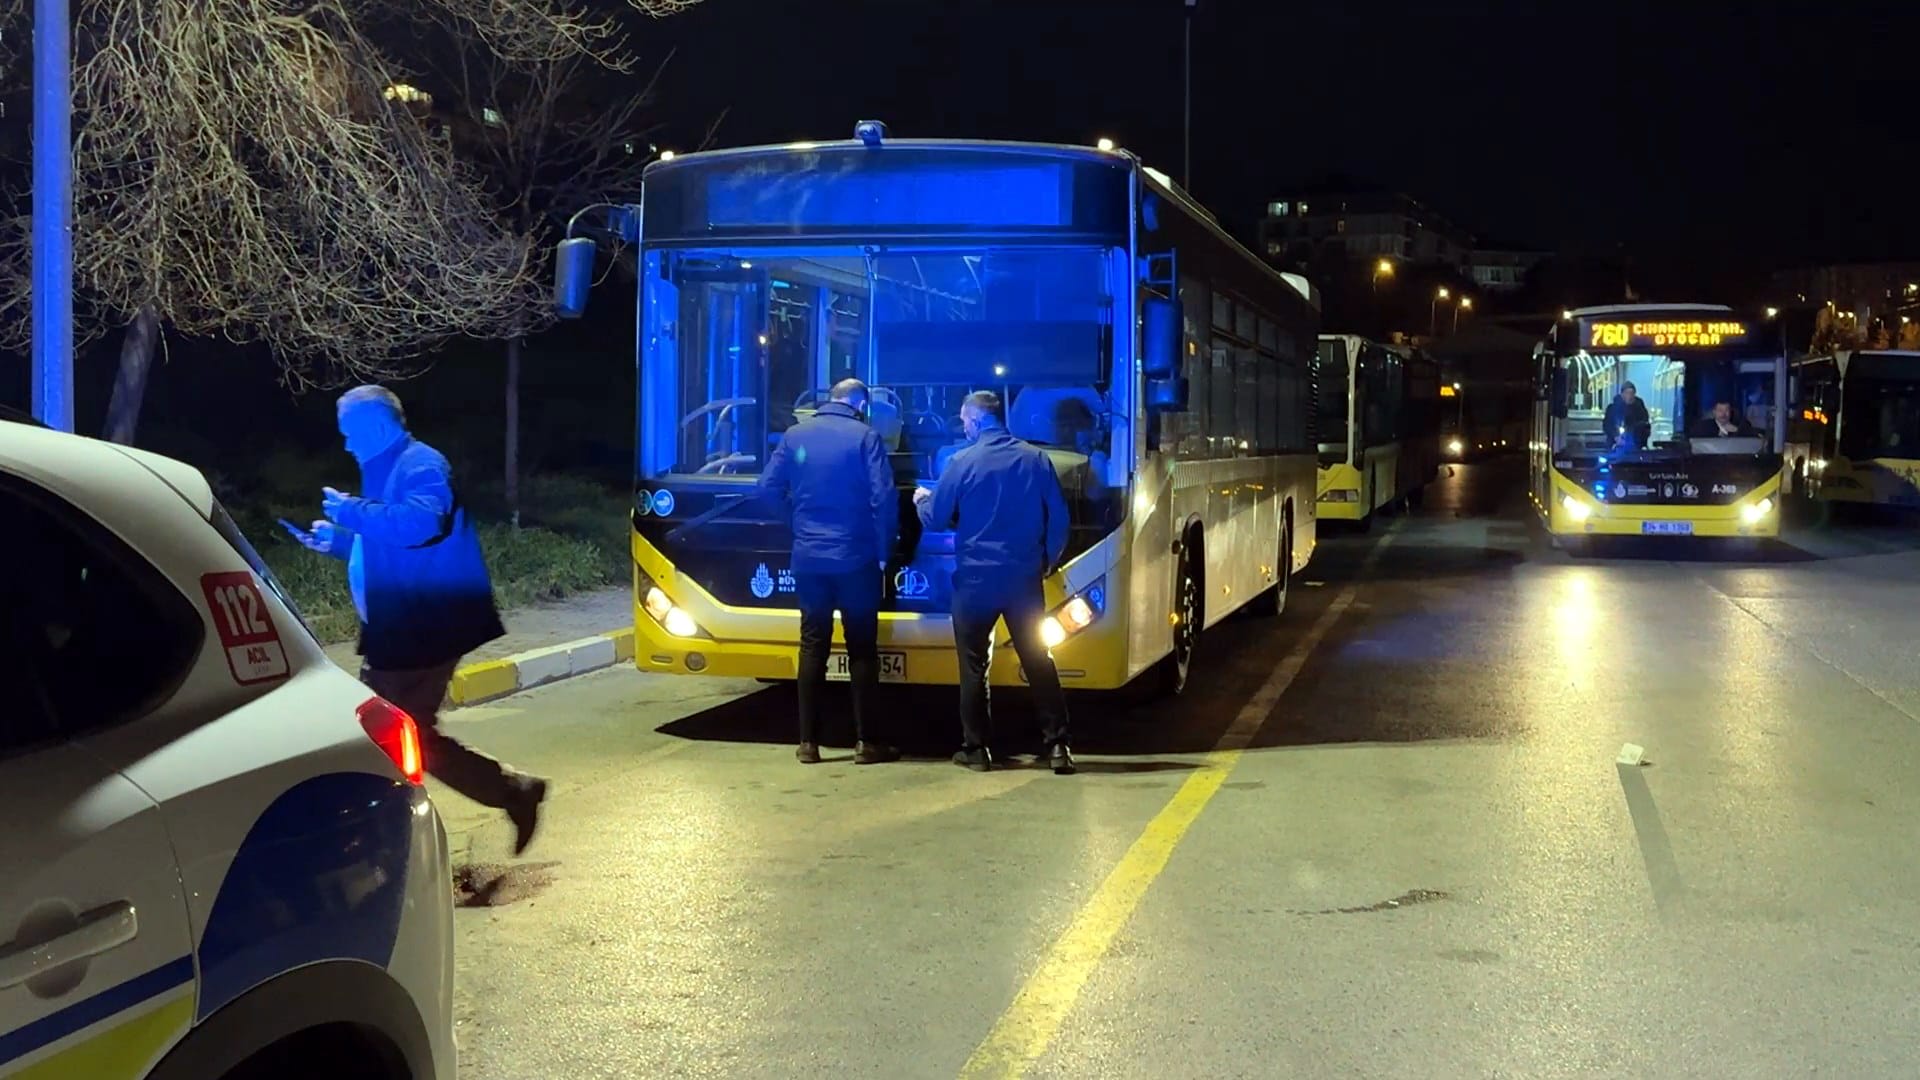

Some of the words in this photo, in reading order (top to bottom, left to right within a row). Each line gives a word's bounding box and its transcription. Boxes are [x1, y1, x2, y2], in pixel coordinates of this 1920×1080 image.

[1591, 323, 1629, 346] 760
[1707, 322, 1746, 334] MAH.
[1654, 333, 1721, 345] OTOGAR
[214, 585, 268, 636] 112
